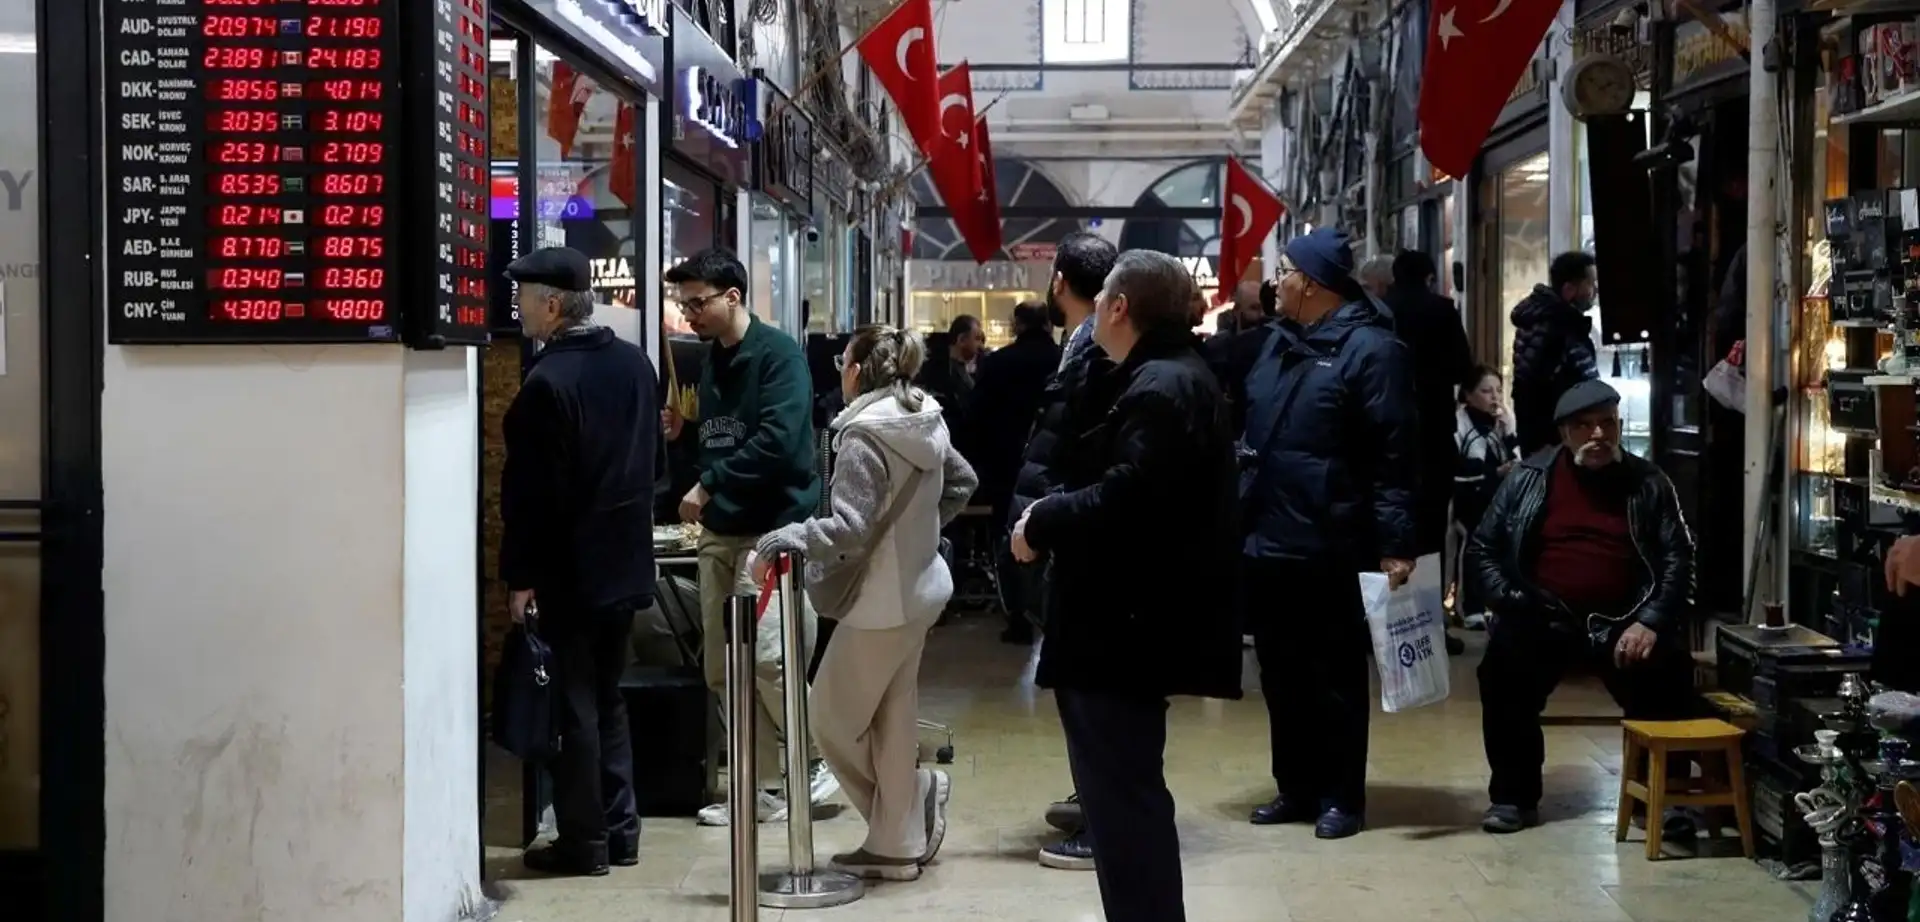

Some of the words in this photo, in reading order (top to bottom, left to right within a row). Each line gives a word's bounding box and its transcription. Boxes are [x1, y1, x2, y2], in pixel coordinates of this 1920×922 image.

[121, 18, 154, 34] AUD-
[204, 16, 276, 36] 20.974
[308, 17, 379, 37] 21.190
[121, 50, 155, 65] CAD-
[205, 48, 277, 68] 23.891
[308, 48, 380, 68] 24.183
[122, 82, 157, 97] DKK-
[222, 80, 276, 99] 3.856
[325, 80, 381, 99] 4.014
[122, 114, 155, 129] SEK-
[222, 112, 277, 131] 3.035
[326, 111, 381, 131] 3.104
[123, 145, 158, 160] NOK-
[222, 143, 279, 162] 2.531
[324, 143, 382, 162] 2.709
[123, 177, 156, 192] SAR-
[222, 174, 278, 194] 8.535
[325, 174, 382, 194] 8.607
[123, 208, 154, 223] JPY-
[223, 206, 281, 225] 0.214
[326, 205, 382, 225] 0.219
[124, 240, 157, 255] AED-
[223, 238, 280, 257] 8.770
[326, 237, 381, 256] 8.875
[124, 271, 158, 286] RUB-
[224, 269, 281, 288] 0.340
[326, 269, 383, 288] 0.360
[124, 303, 158, 317] CNY-
[225, 300, 281, 319] 4.300
[328, 300, 383, 319] 4.800
